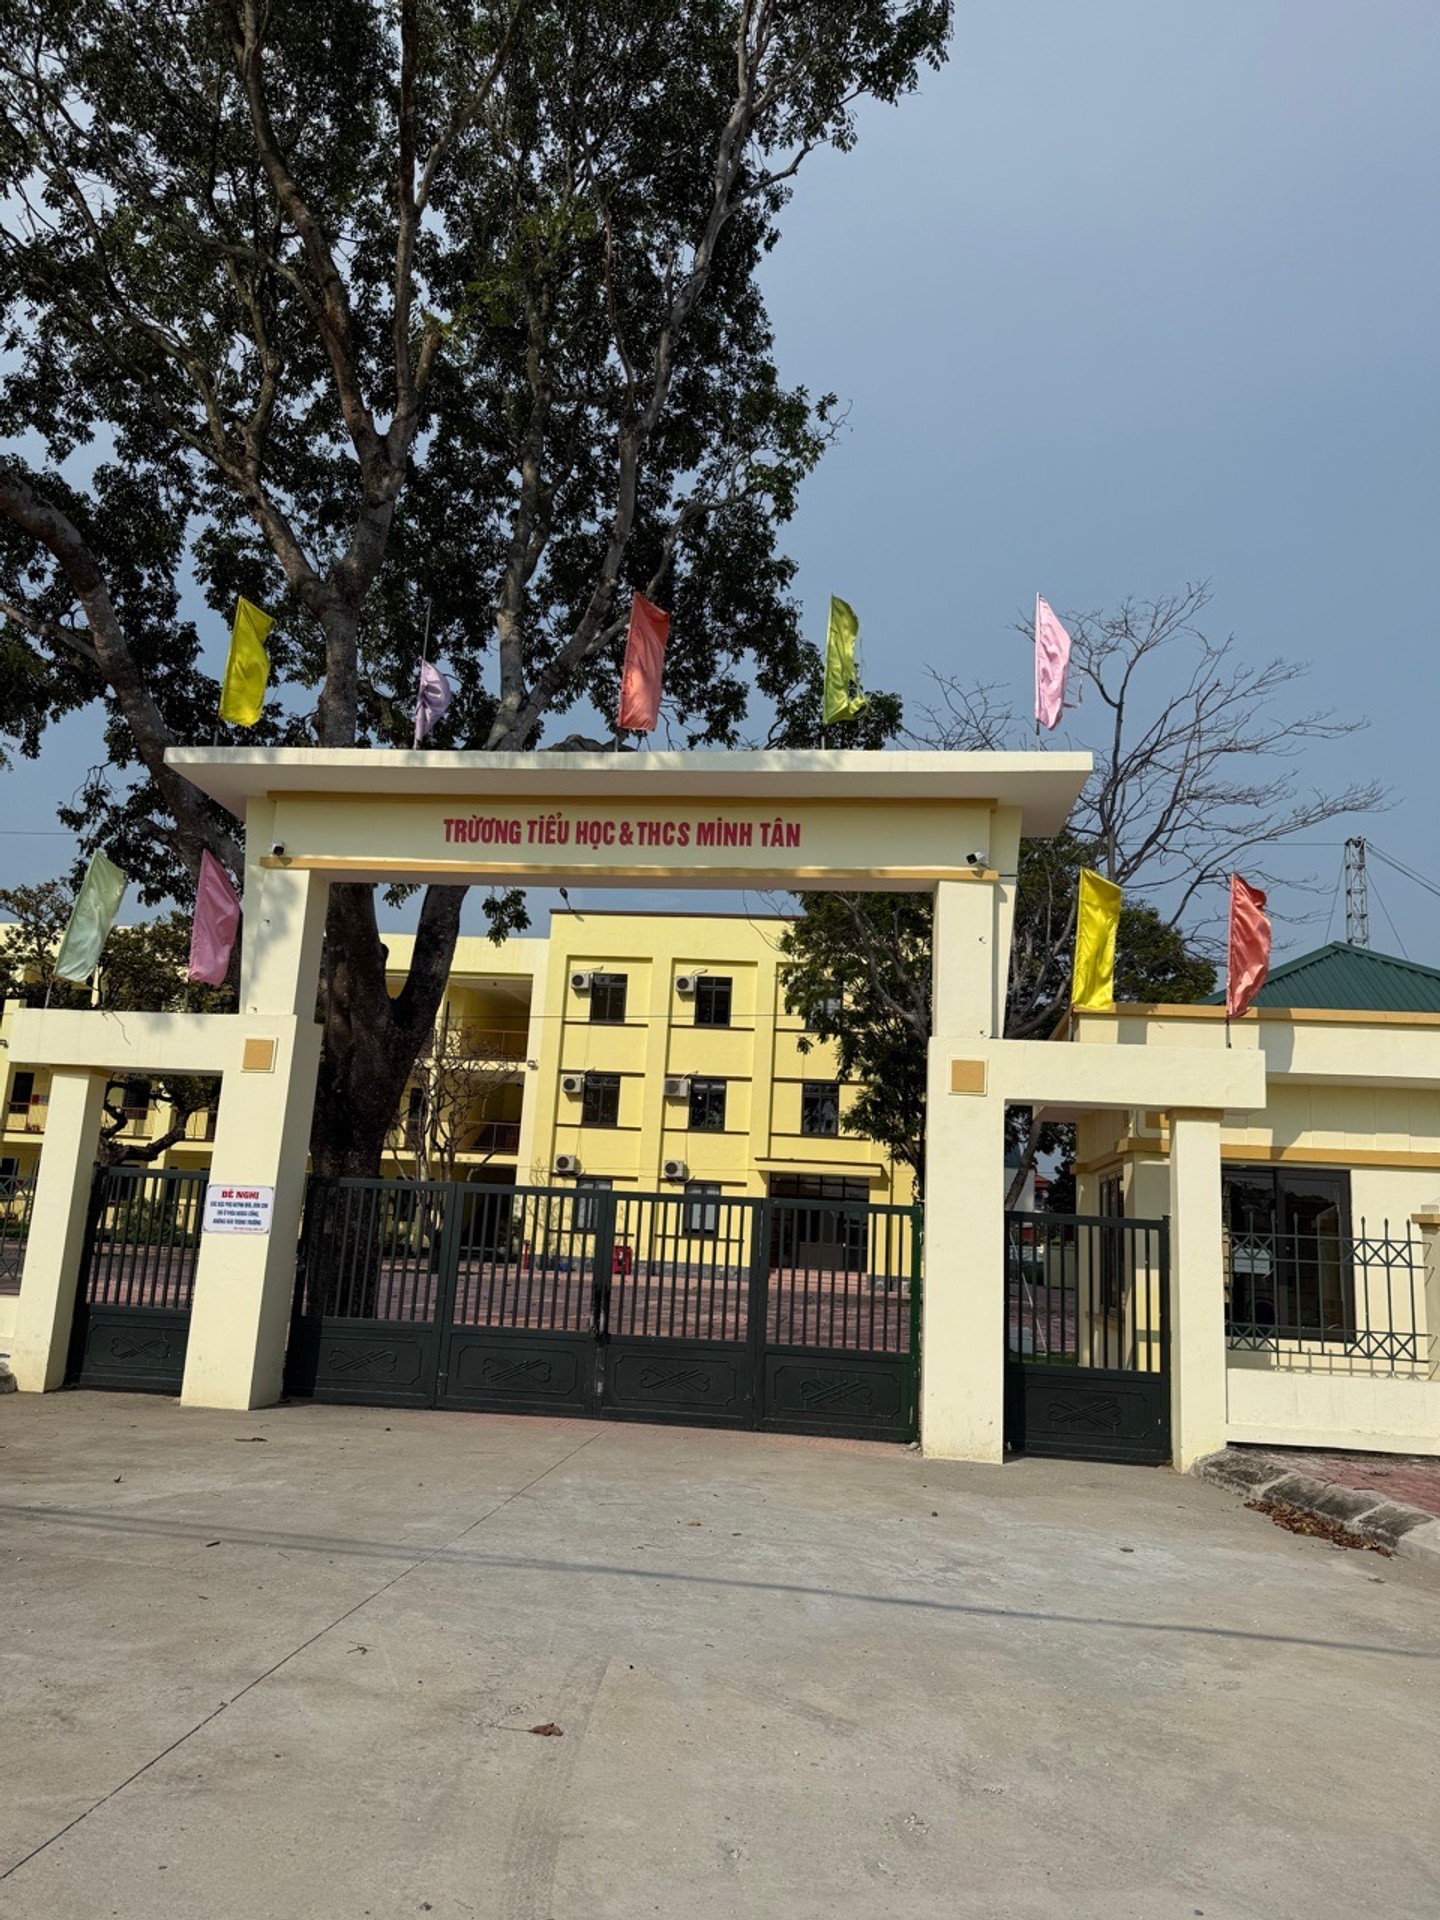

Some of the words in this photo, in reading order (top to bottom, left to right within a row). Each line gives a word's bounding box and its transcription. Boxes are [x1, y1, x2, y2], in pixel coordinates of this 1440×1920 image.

[575, 820, 616, 850] HỌC
[619, 820, 634, 846] &
[636, 821, 691, 847] THCS
[759, 817, 801, 848] TÂN
